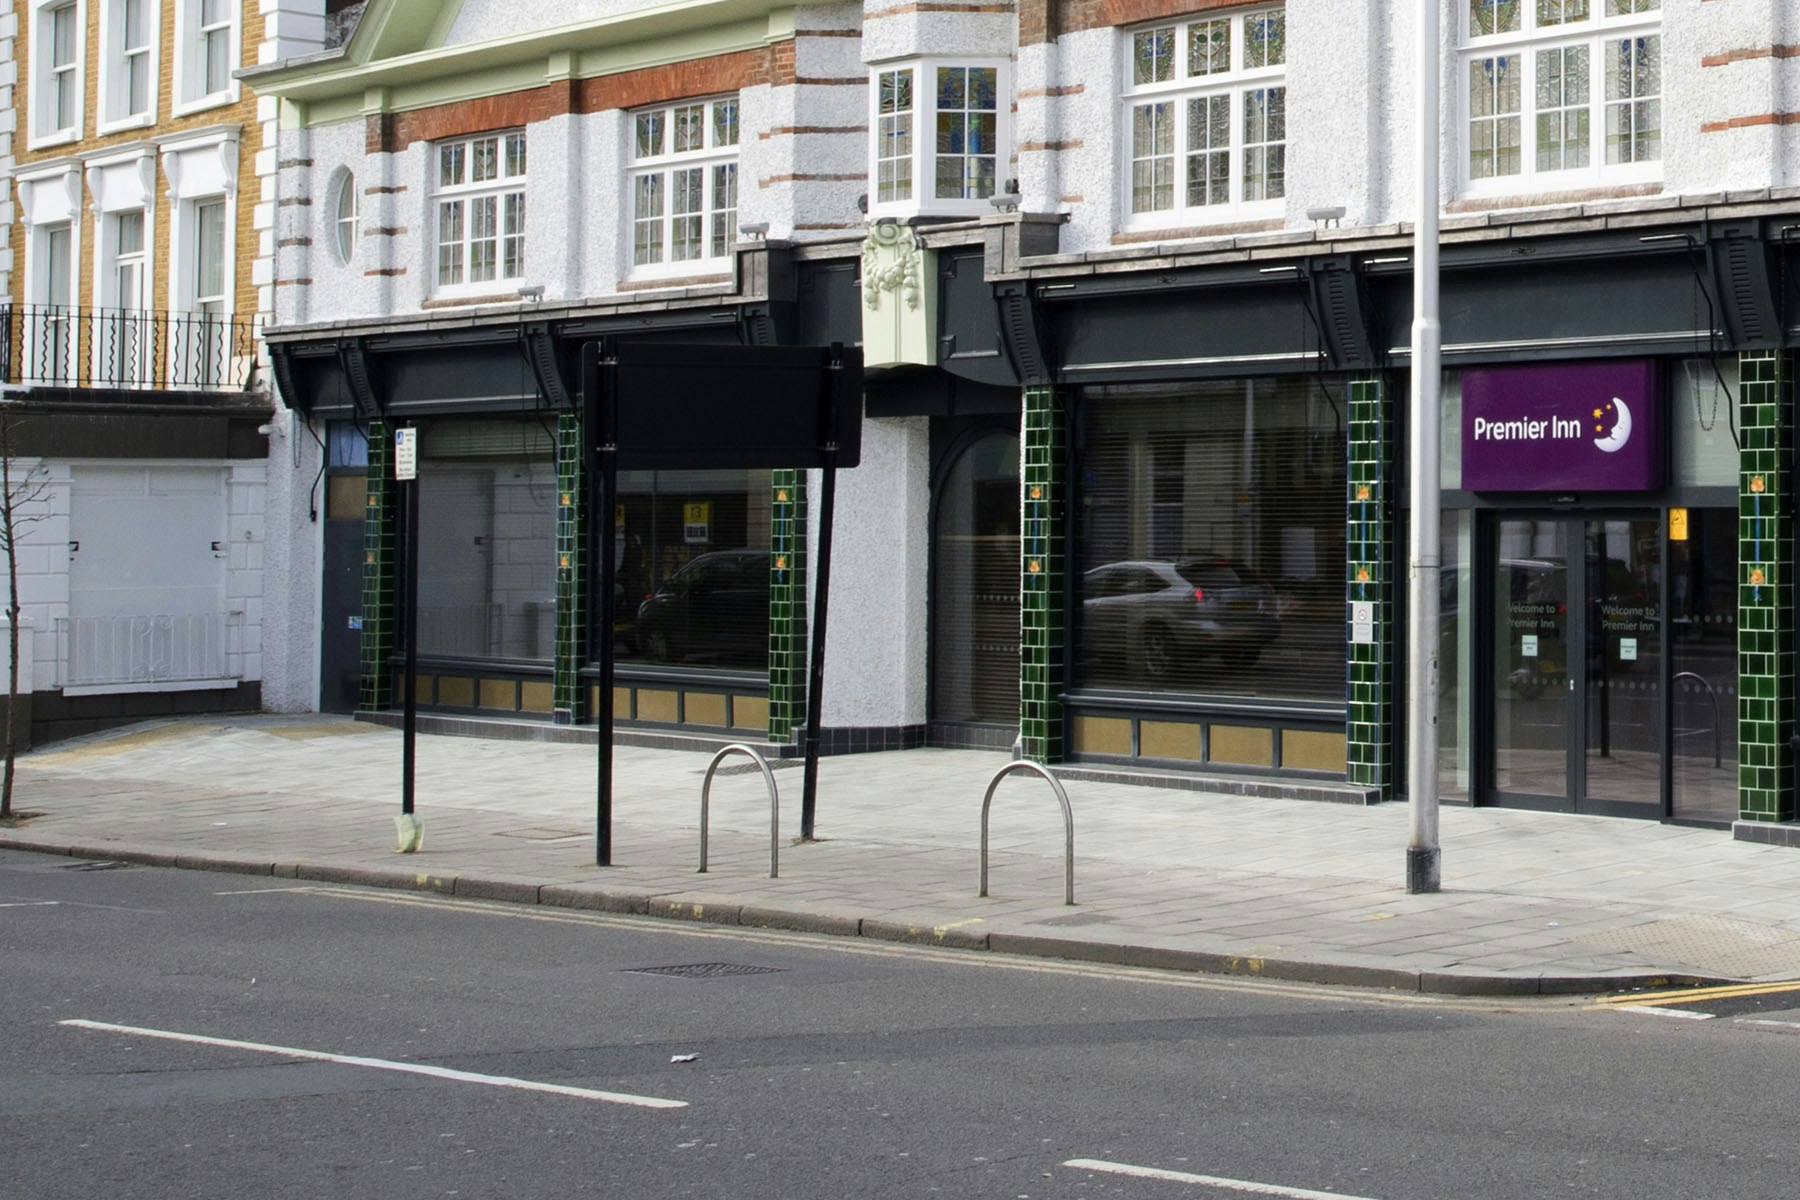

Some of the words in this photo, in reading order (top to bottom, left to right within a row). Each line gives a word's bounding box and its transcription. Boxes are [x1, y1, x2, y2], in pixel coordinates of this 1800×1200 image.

[1474, 416, 1548, 440] Premier
[1552, 415, 1581, 439] Inn
[1546, 604, 1556, 614] to
[1601, 604, 1644, 616] Welcome
[1645, 606, 1656, 616] to
[1540, 618, 1556, 629] Inn
[1602, 619, 1638, 631] Premier
[1639, 620, 1655, 631] Inn
